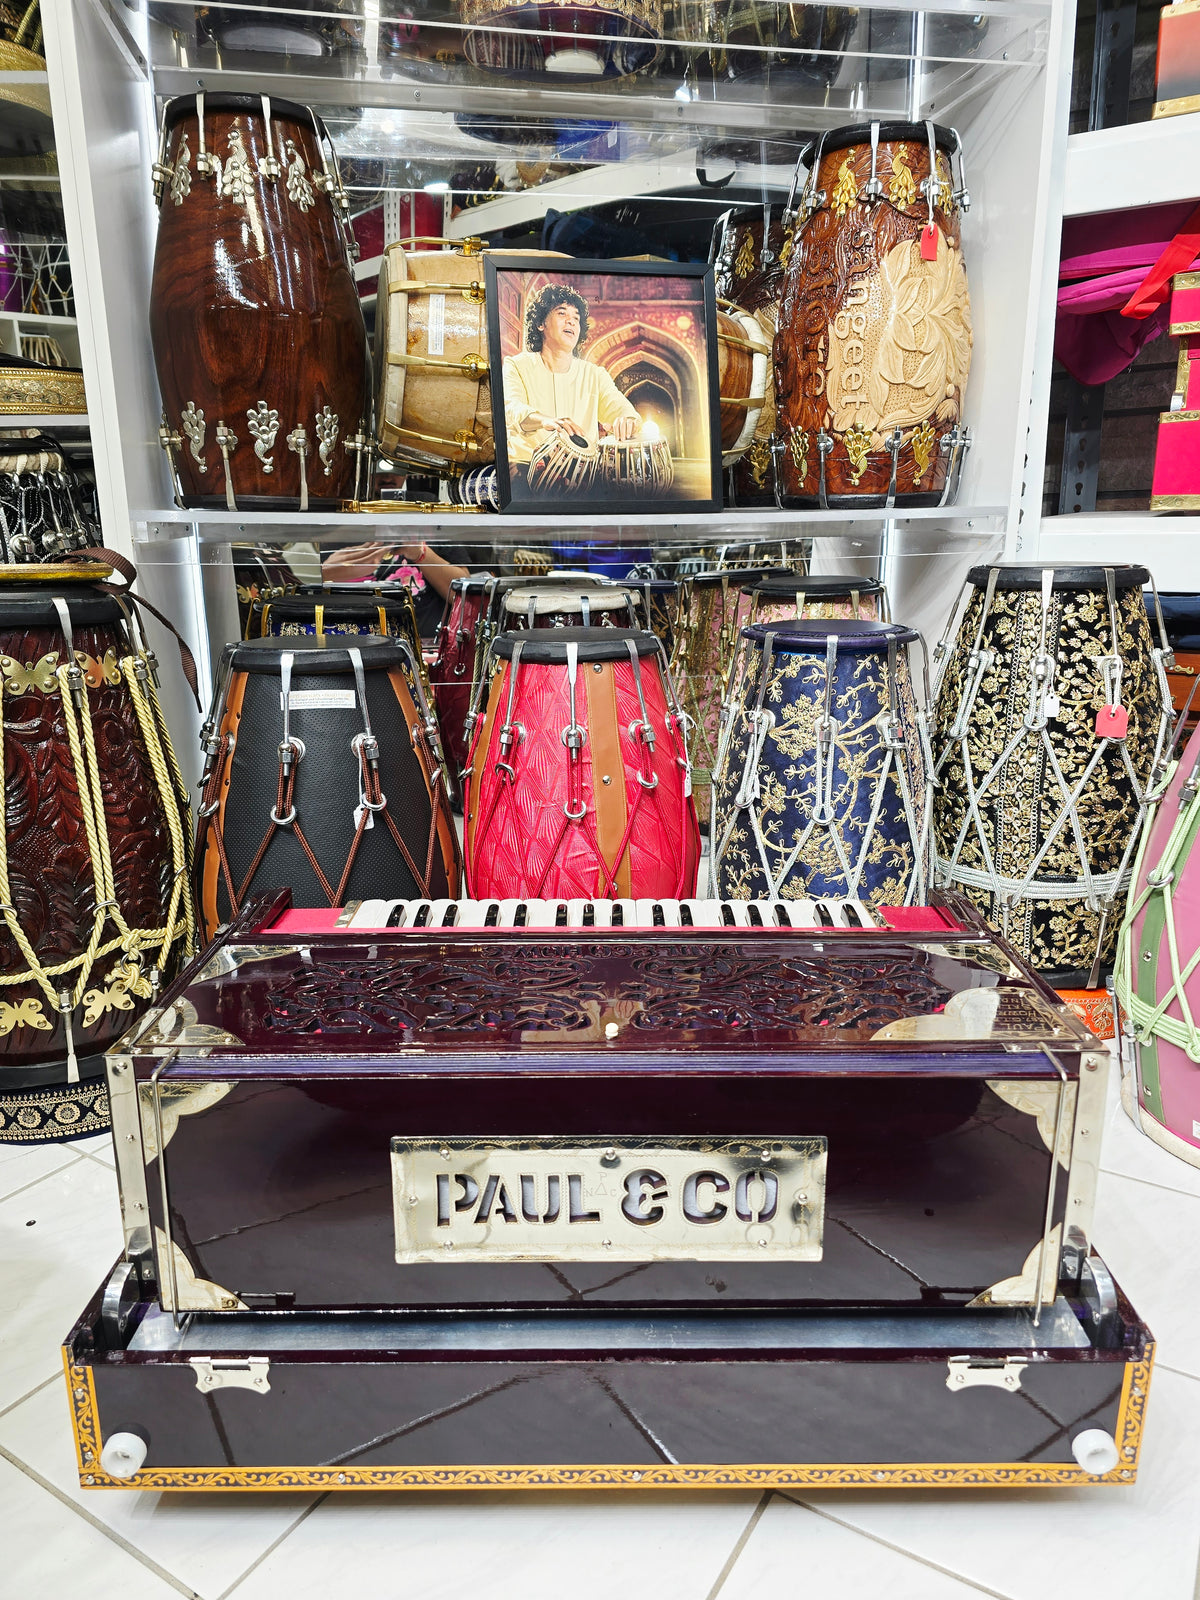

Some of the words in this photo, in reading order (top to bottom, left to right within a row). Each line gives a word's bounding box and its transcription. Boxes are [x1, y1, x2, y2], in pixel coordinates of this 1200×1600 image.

[1000, 1023, 1046, 1031] PAUL
[436, 1172, 601, 1228] PAUL
[620, 1167, 669, 1227] &
[682, 1169, 780, 1225] CO
